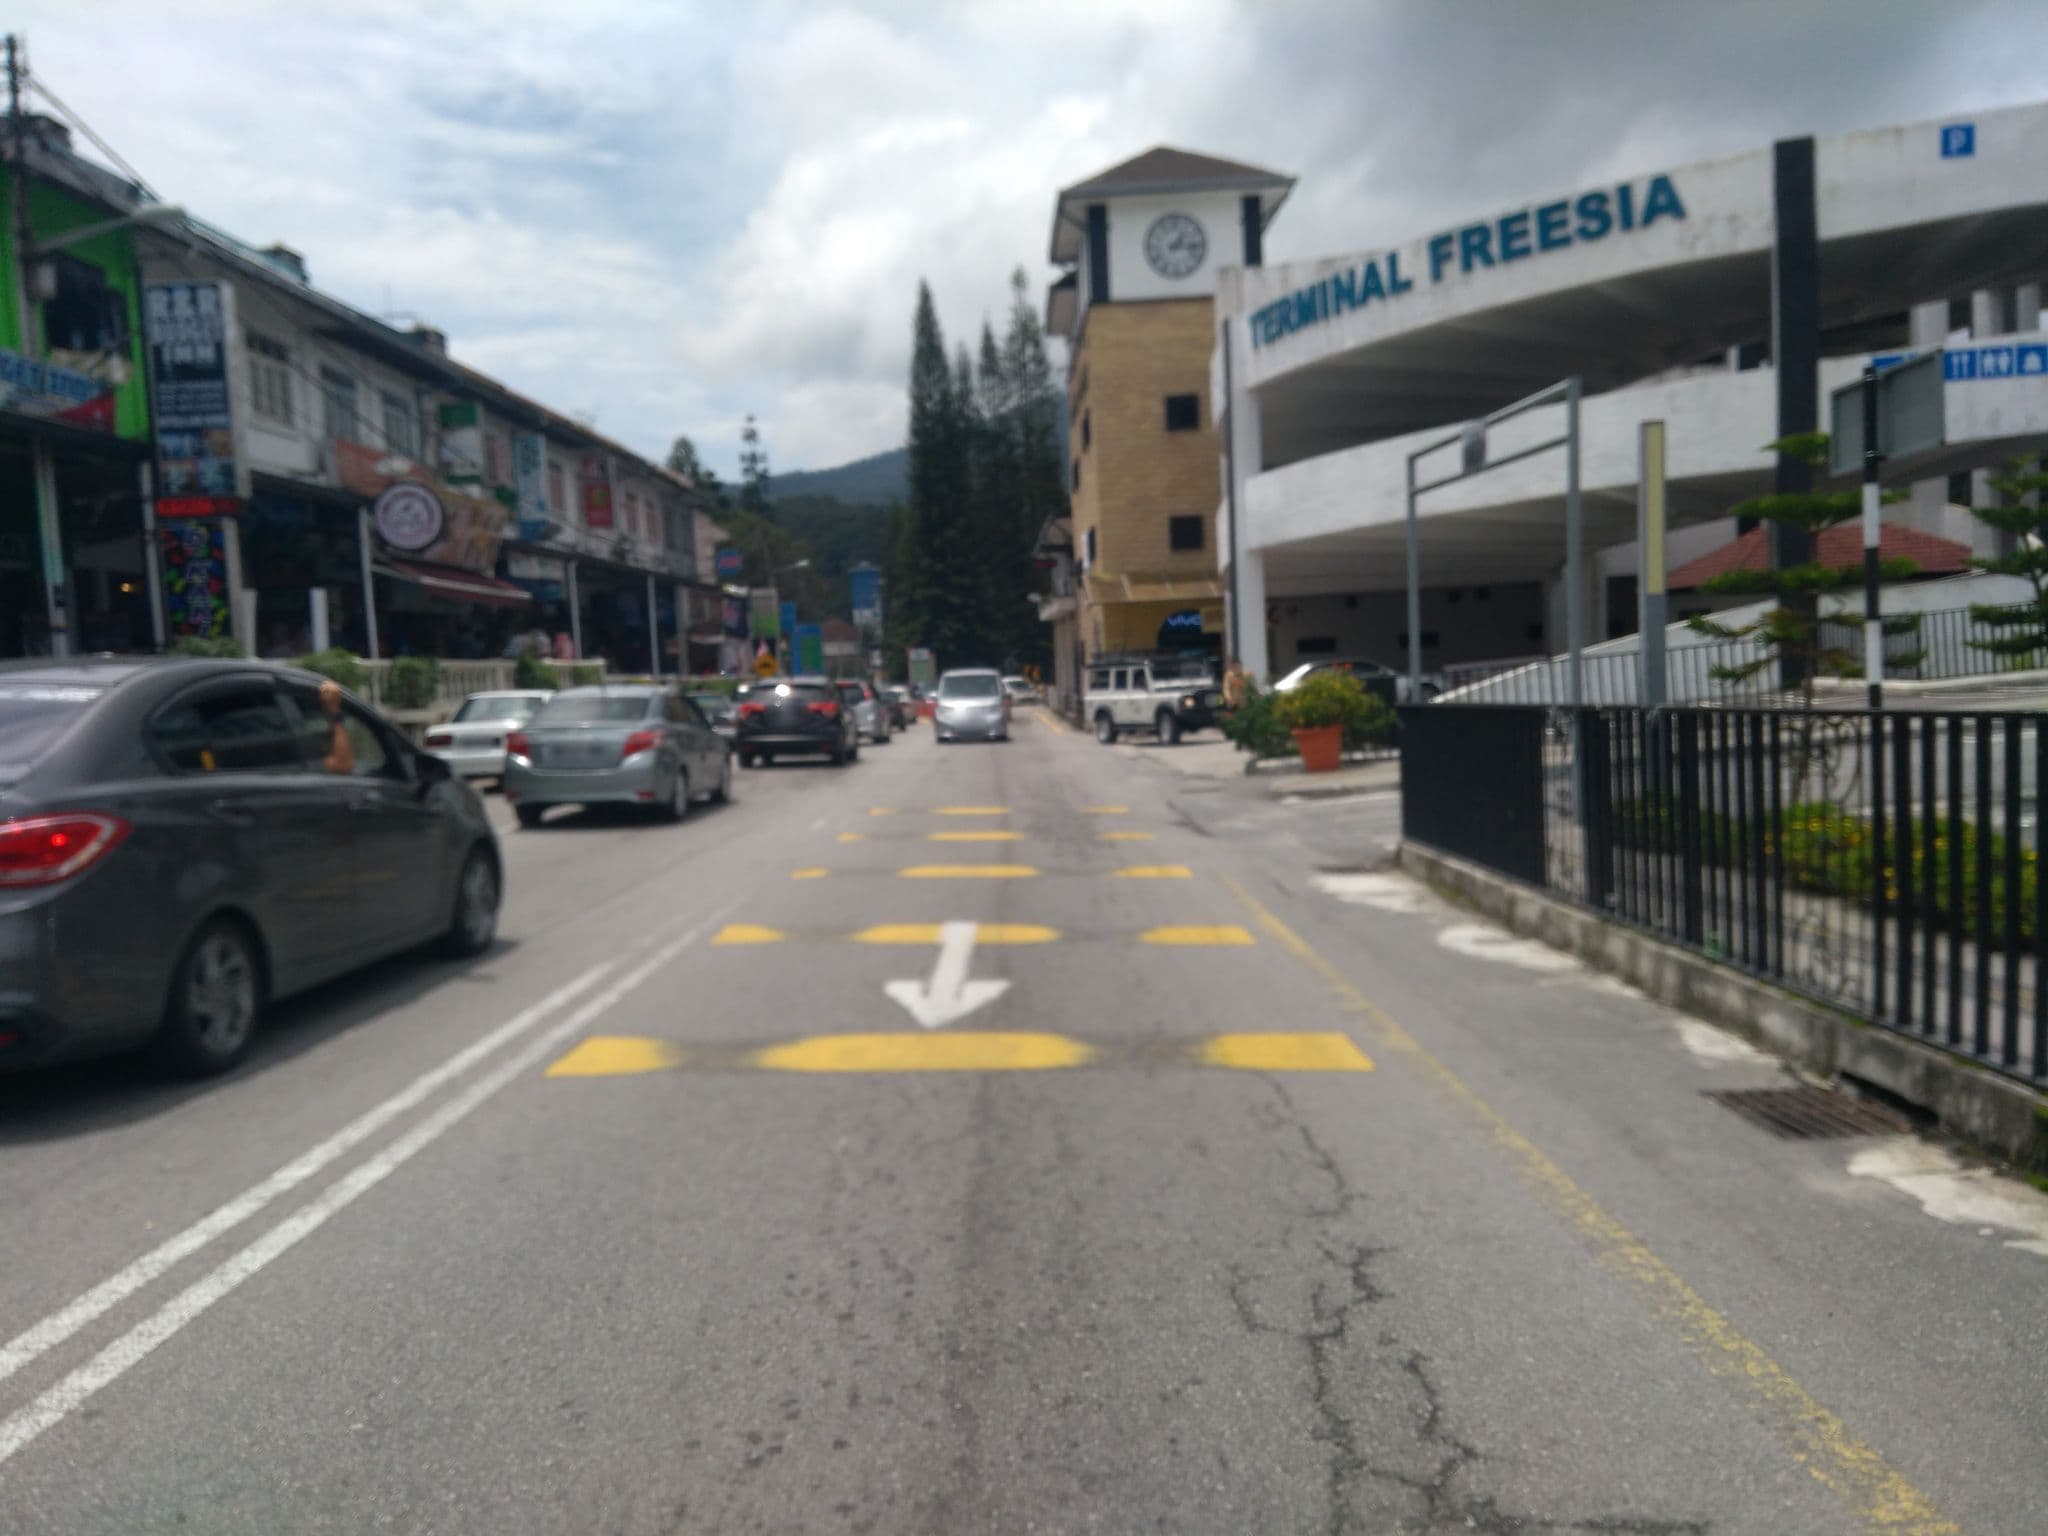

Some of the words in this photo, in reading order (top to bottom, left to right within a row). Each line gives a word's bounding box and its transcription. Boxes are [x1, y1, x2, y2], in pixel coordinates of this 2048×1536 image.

[1950, 129, 1967, 155] P
[1249, 250, 1413, 349] TERMINAL
[1428, 172, 1686, 282] FREESIA
